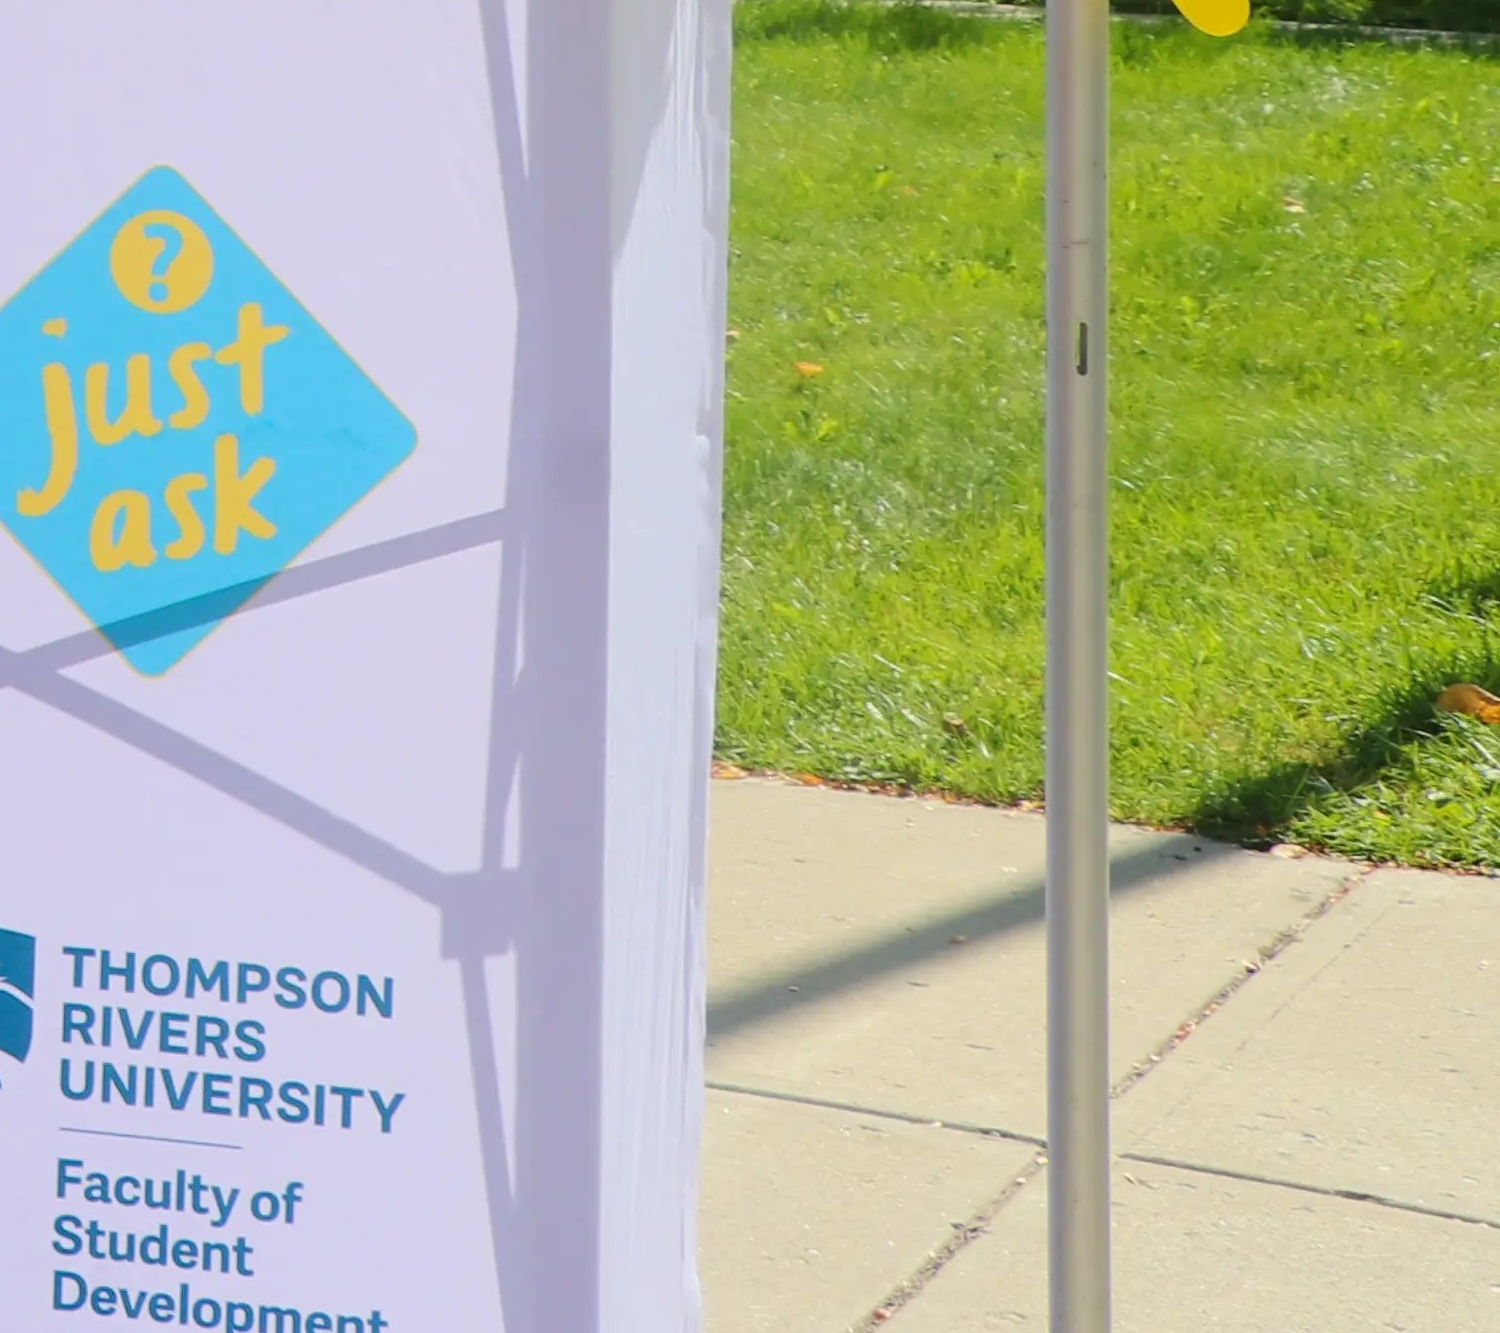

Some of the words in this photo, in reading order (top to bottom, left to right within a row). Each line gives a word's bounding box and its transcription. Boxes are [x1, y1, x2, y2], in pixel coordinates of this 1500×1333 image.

[16, 302, 290, 515] just
[90, 434, 277, 571] ask
[61, 946, 395, 1019] THOMPSON
[60, 1002, 267, 1061] RIVERS
[59, 1059, 406, 1133] UNIVERSITY
[56, 1158, 239, 1226] Faculty
[249, 1181, 303, 1224] of
[52, 1215, 254, 1276] Student
[52, 1270, 389, 1333] Development
